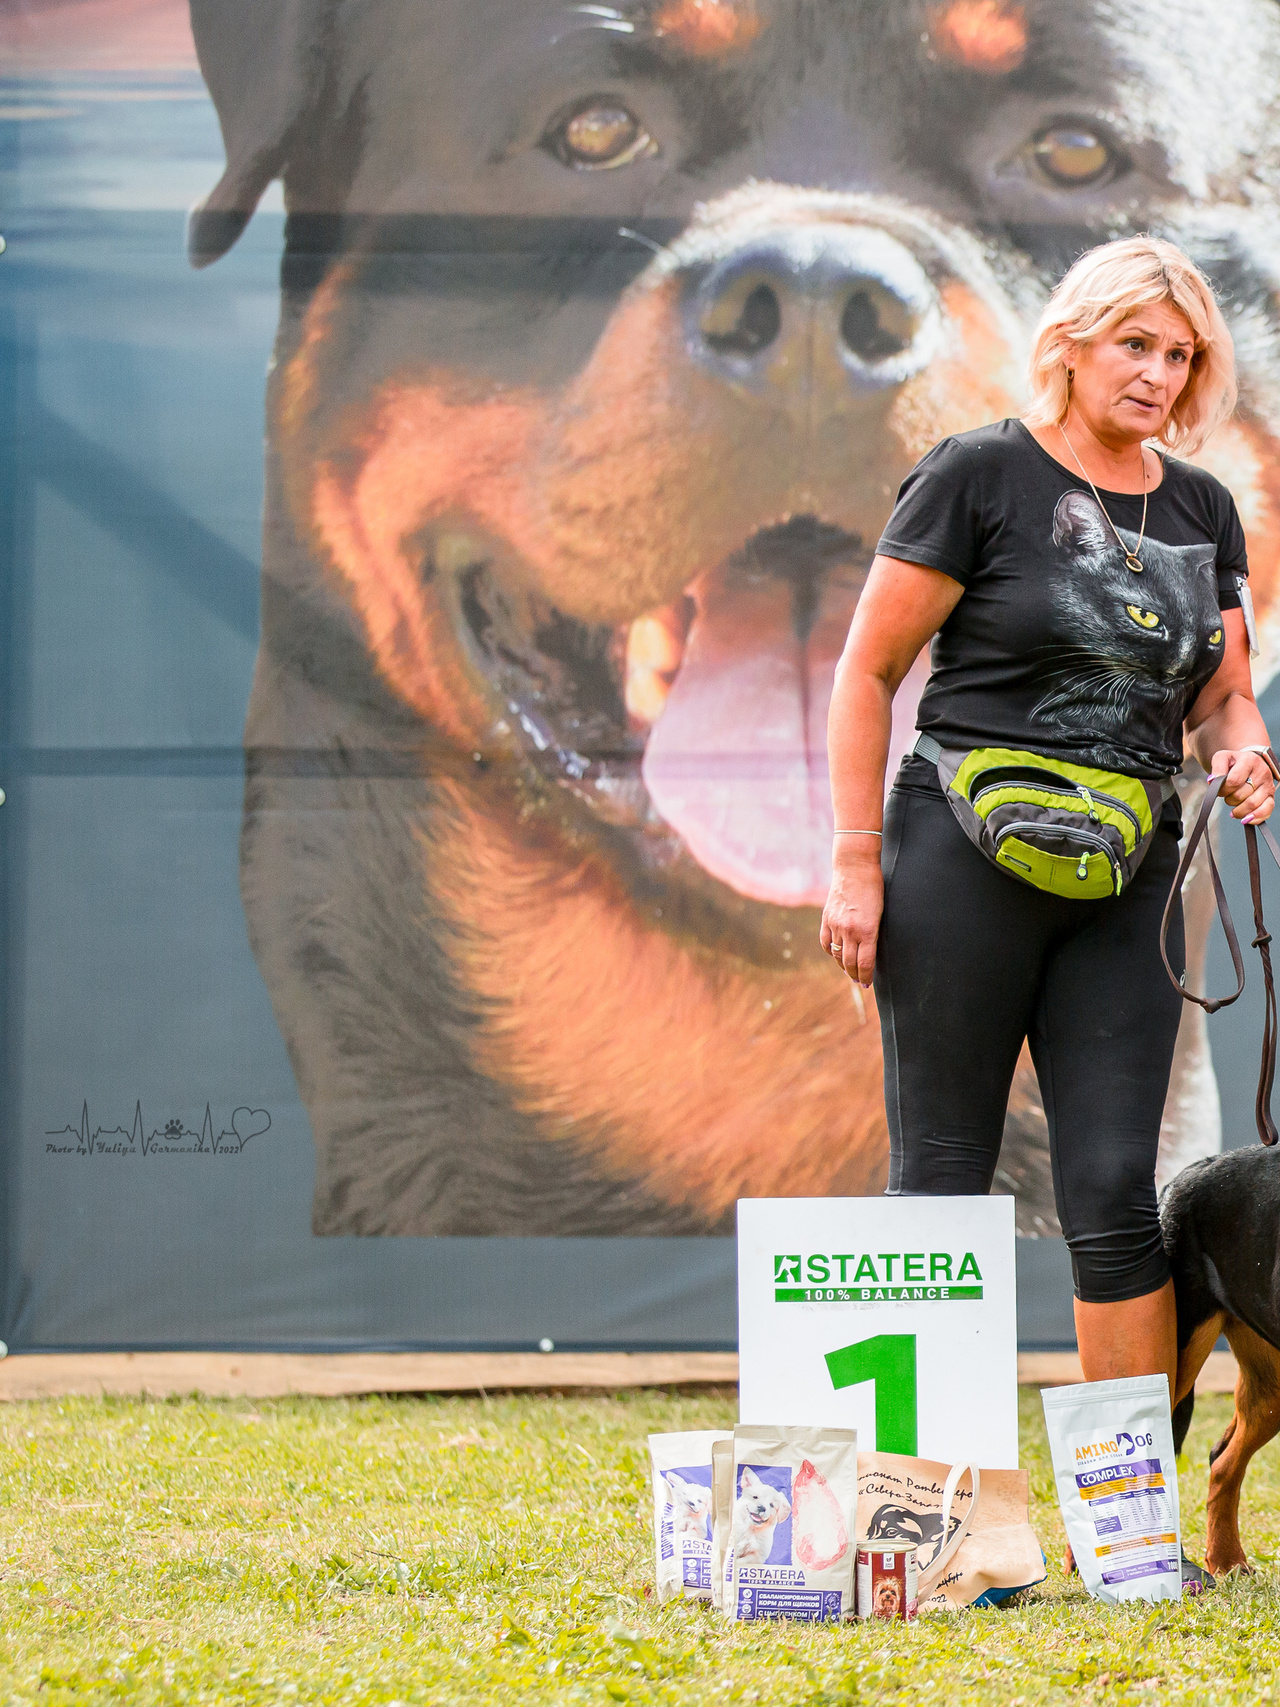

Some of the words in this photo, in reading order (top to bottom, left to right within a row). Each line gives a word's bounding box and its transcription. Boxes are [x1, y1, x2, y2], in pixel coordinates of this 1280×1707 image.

[806, 1252, 984, 1284] STATERA
[804, 1289, 851, 1301] 100%
[861, 1288, 951, 1300] BALANCE
[823, 1333, 919, 1458] 1
[1081, 1465, 1136, 1486] COMPLEX
[749, 1568, 806, 1580] STATERA
[758, 1593, 820, 1601] СБАЛАНСИРОВАННЫЙ
